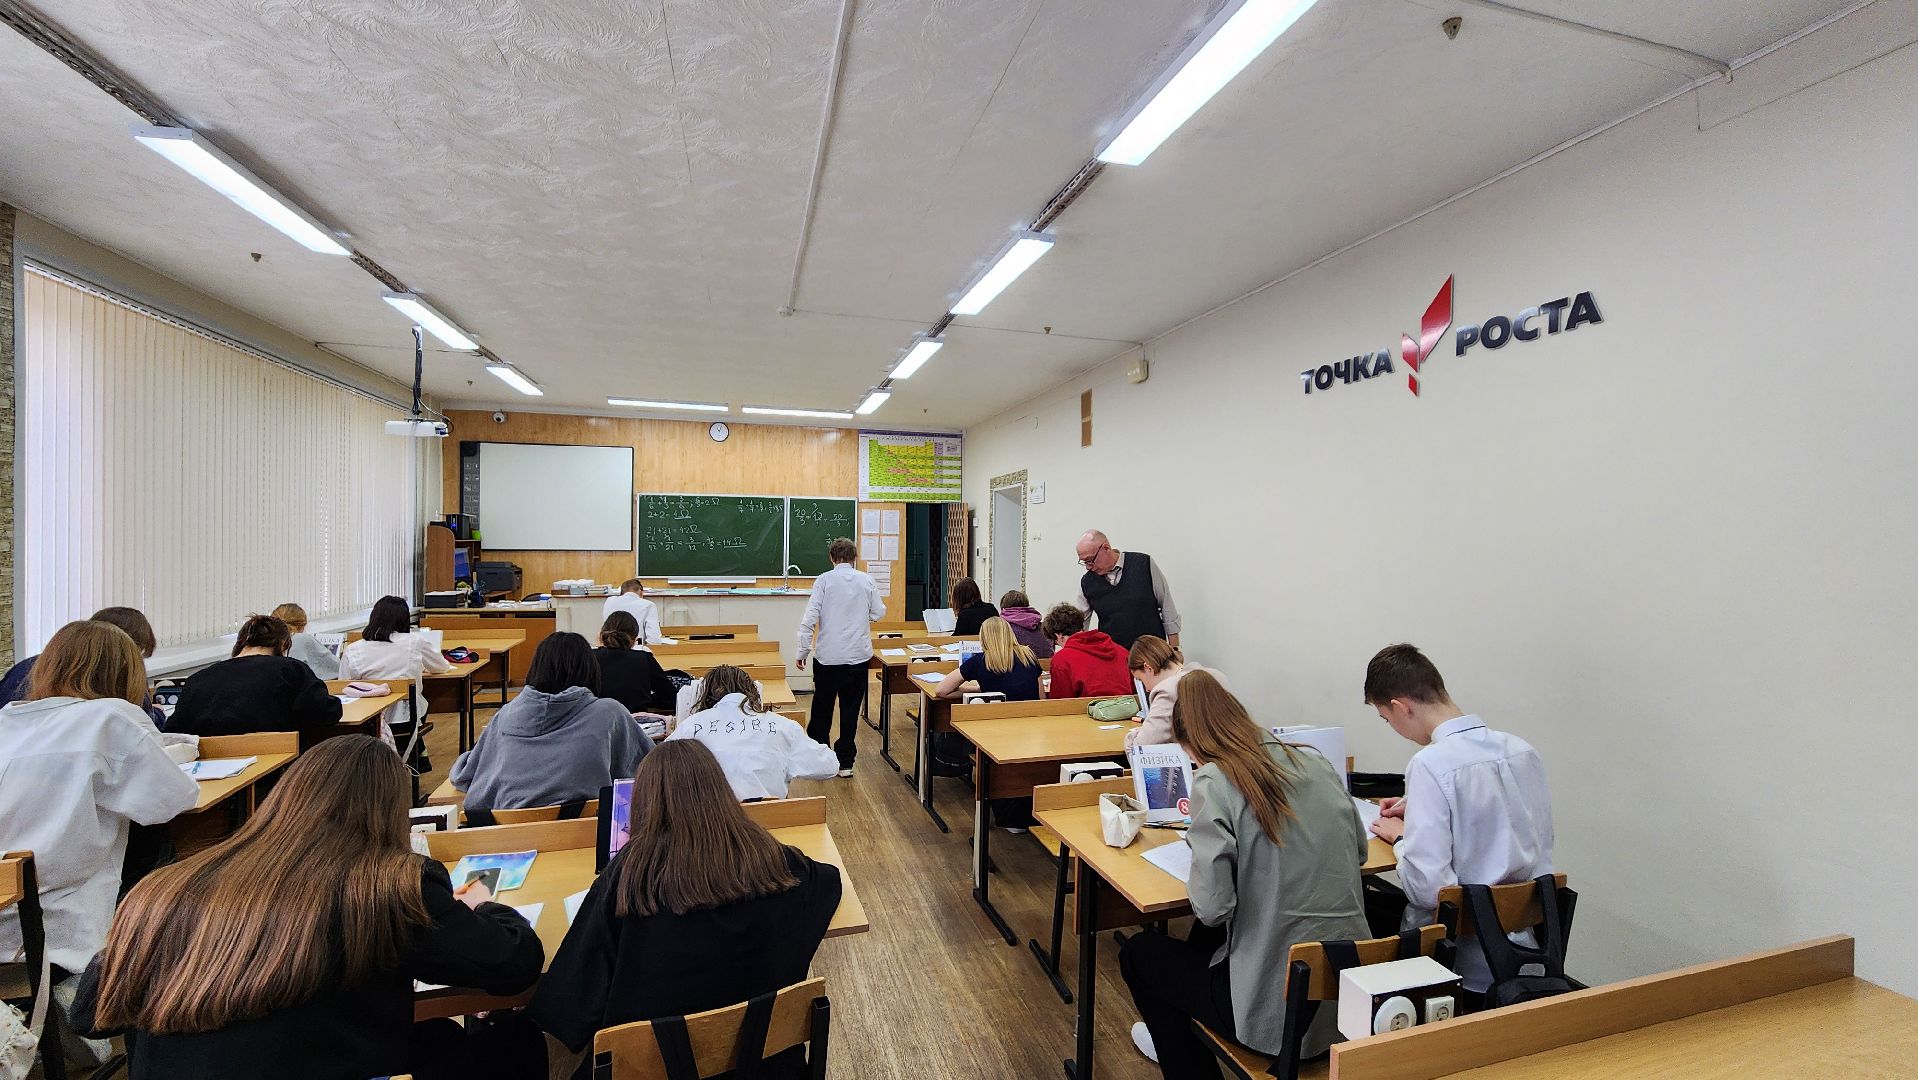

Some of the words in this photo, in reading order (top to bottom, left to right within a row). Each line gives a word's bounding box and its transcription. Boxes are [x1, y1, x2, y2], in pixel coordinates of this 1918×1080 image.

[1301, 348, 1395, 394] ТОЧКА
[1456, 291, 1603, 357] РОСТА
[693, 719, 777, 737] DESIRE
[1140, 755, 1182, 765] ФИЗИКА
[1181, 801, 1189, 814] 8
